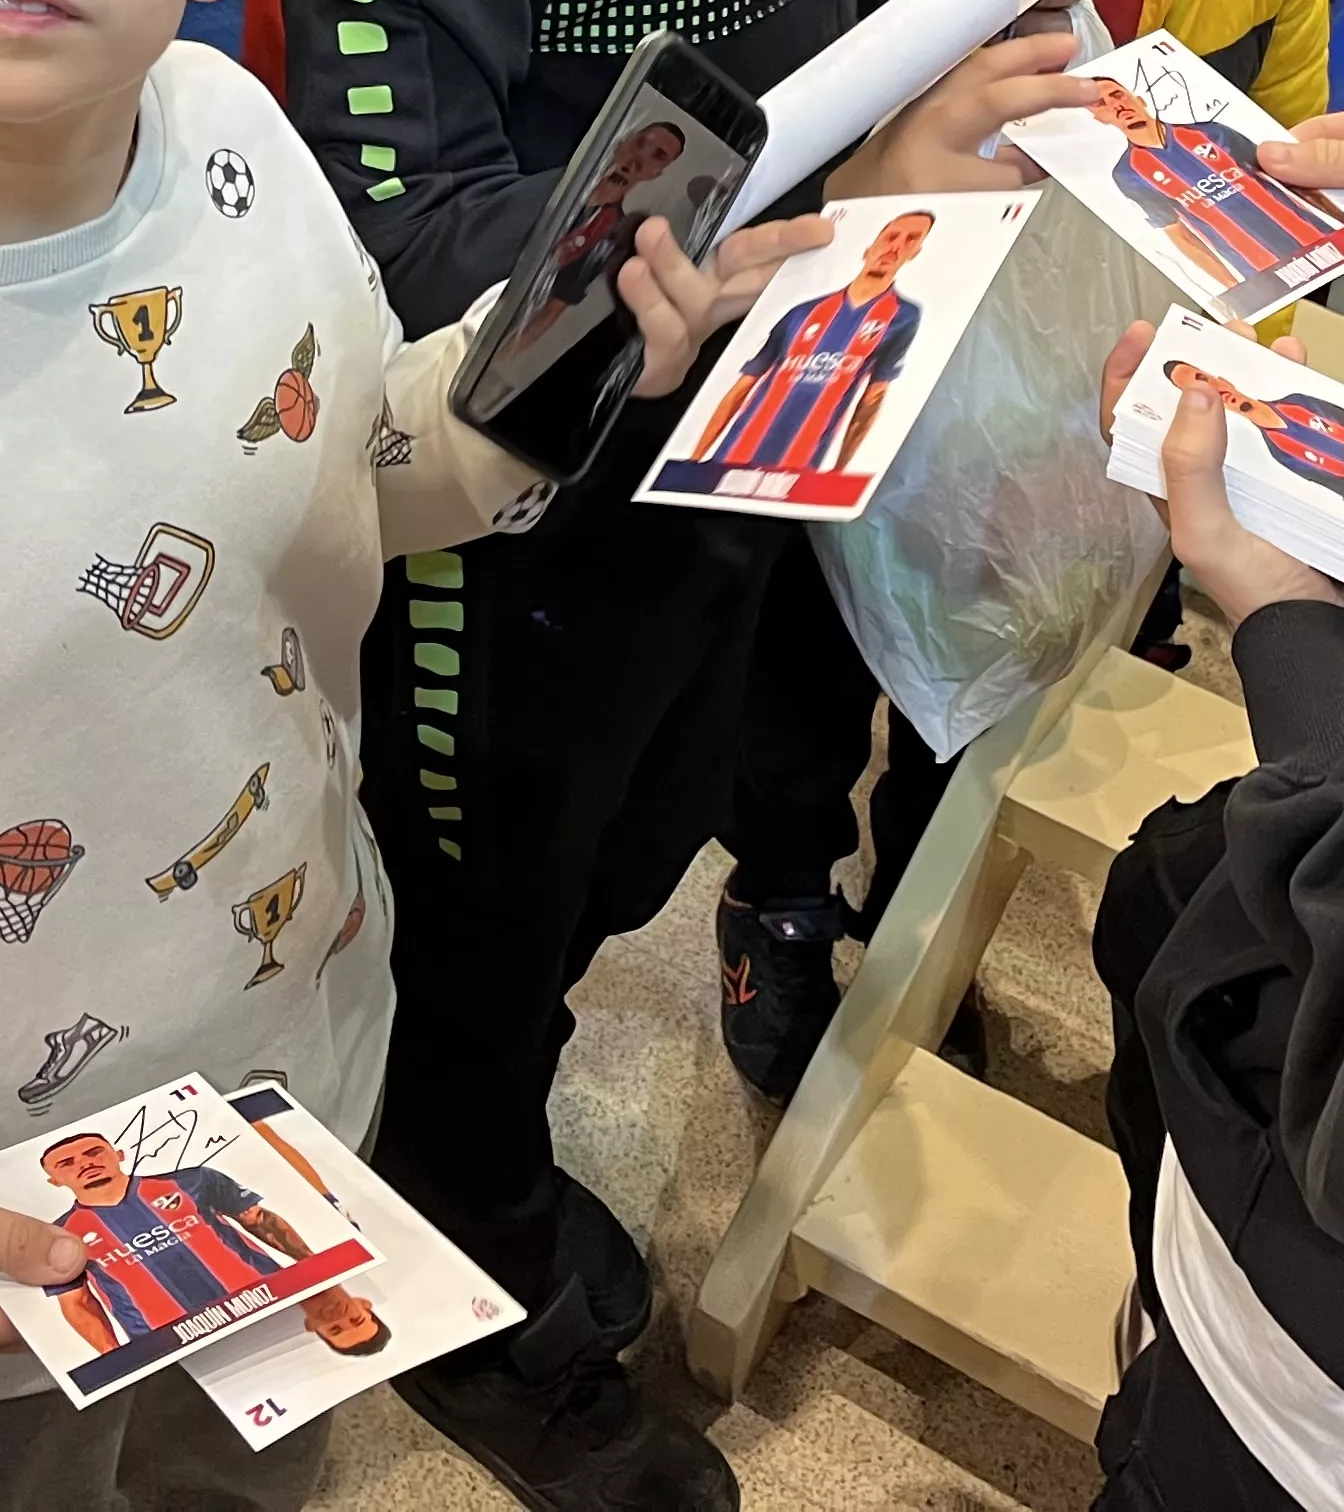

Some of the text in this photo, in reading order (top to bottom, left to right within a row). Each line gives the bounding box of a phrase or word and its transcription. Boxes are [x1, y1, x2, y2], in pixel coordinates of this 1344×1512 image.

[1151, 41, 1176, 56] 11
[169, 1084, 199, 1101] 11
[172, 1283, 279, 1345] JOAQUÍN MUÑOZ
[244, 1397, 288, 1427] 12
